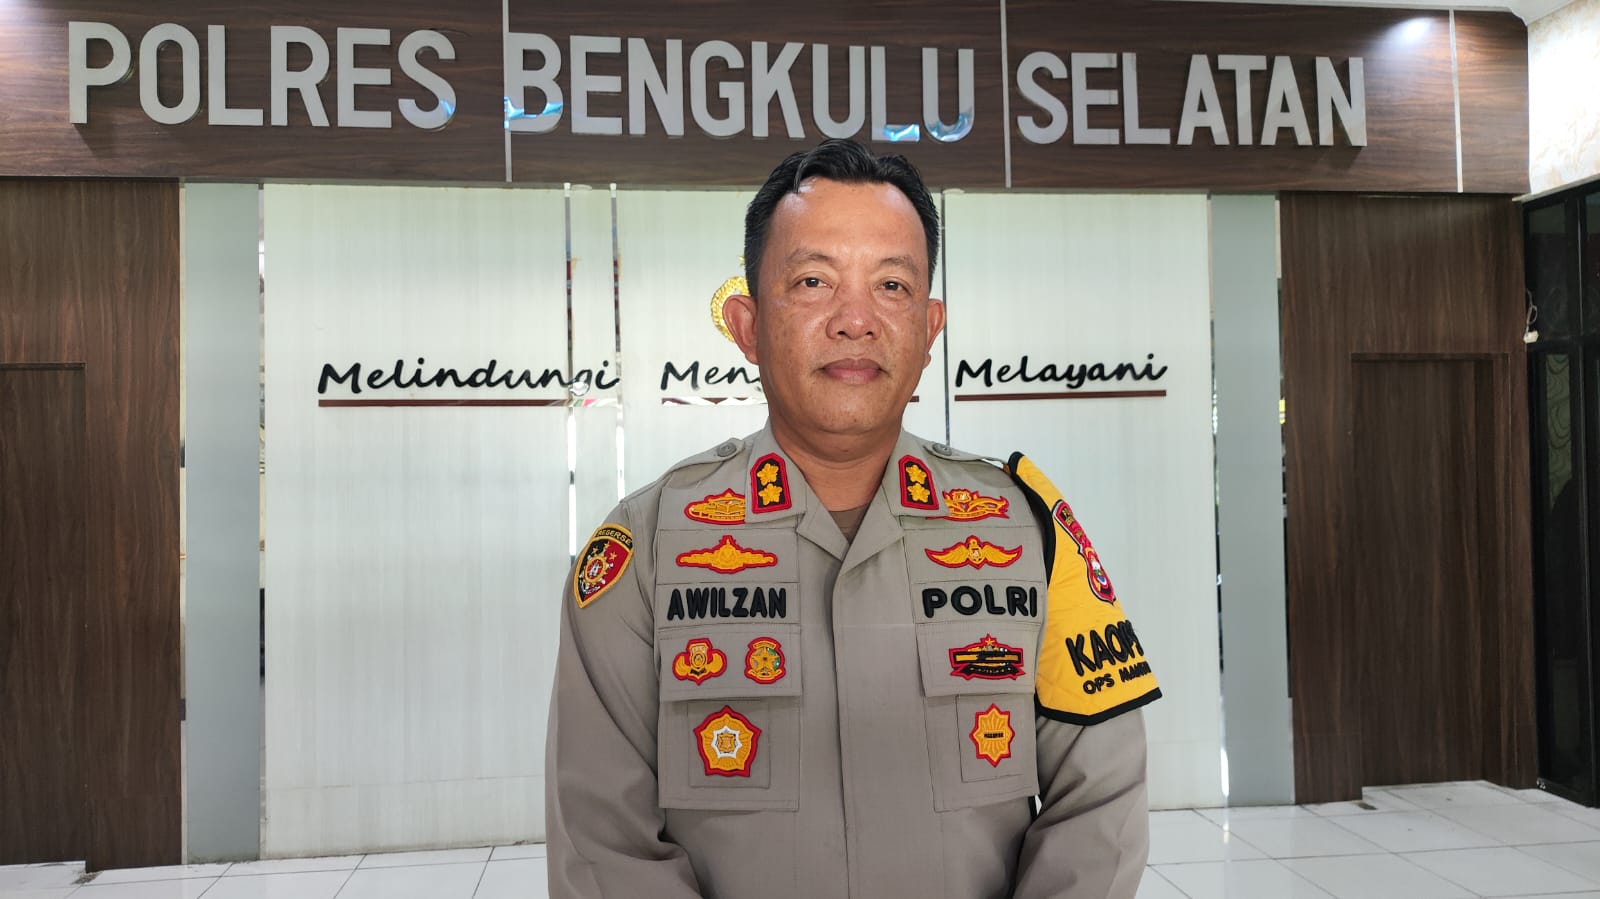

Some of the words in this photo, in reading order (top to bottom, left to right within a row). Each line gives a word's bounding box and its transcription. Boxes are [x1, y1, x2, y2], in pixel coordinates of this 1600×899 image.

[68, 21, 457, 131] POLRES
[504, 31, 975, 142] BENGKULU
[1016, 51, 1368, 147] SELATAN
[318, 357, 621, 397] Melindungi
[955, 353, 1168, 389] Melayani
[667, 587, 787, 621] AWILZAN
[922, 585, 1038, 619] POLRI
[1083, 673, 1115, 695] OPS
